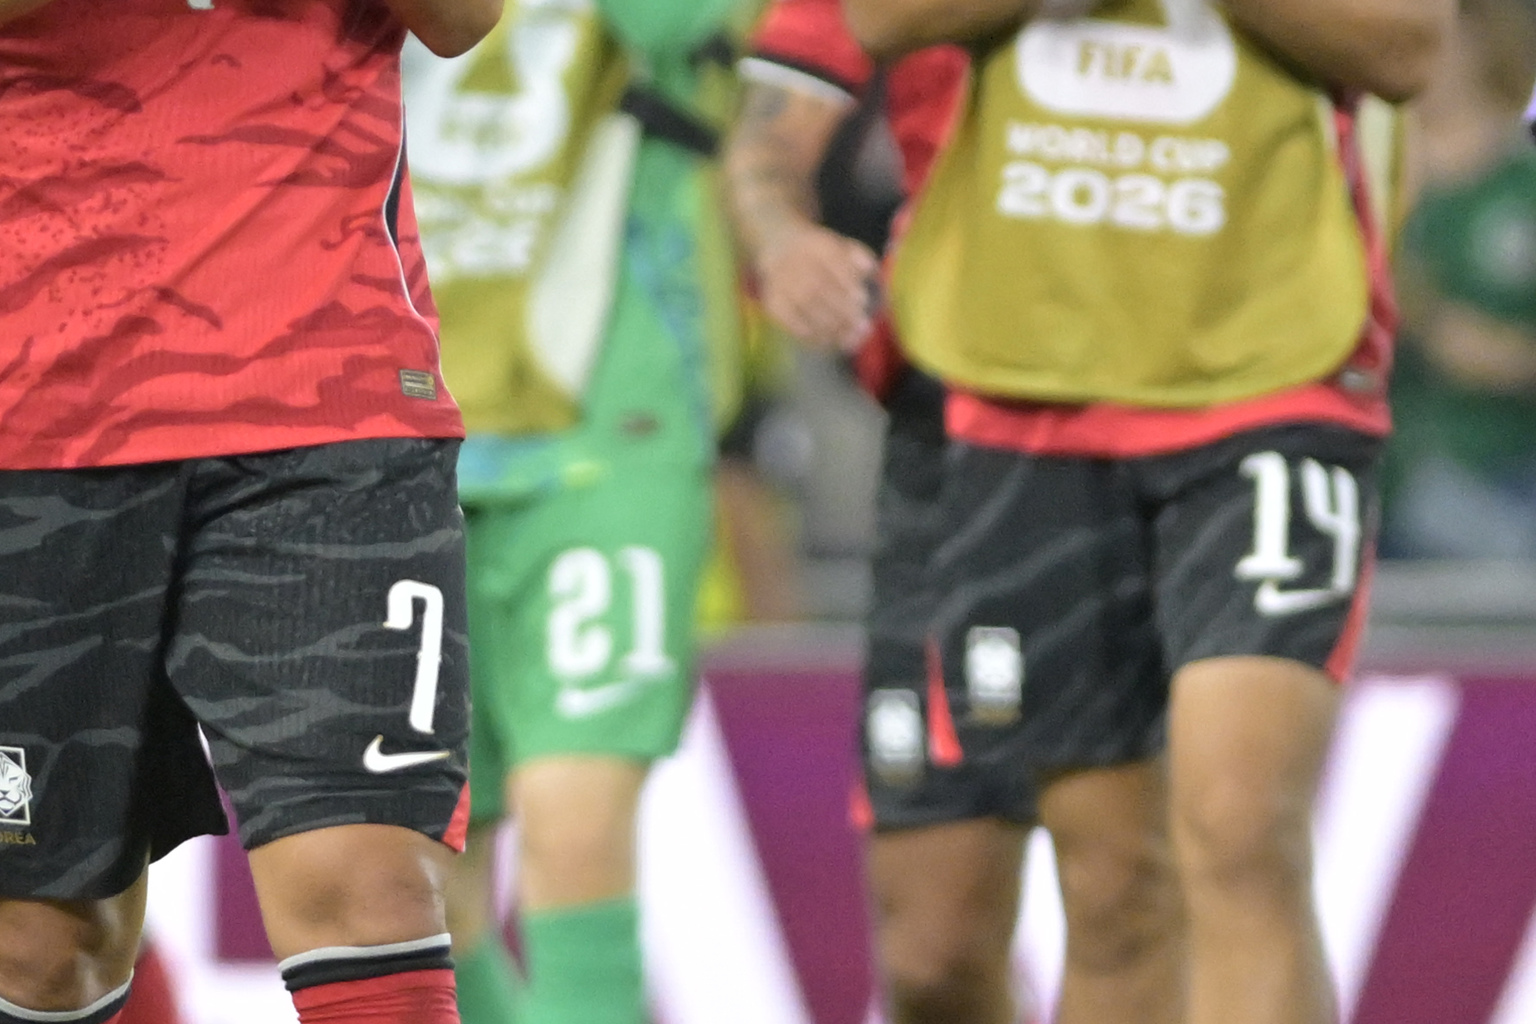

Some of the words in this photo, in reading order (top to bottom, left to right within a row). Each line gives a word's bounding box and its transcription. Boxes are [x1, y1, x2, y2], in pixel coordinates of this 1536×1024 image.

[1075, 38, 1175, 83] FIFA
[997, 160, 1229, 236] 2026
[1005, 118, 1146, 167] WORLD
[1151, 135, 1230, 173] CUP
[1235, 450, 1362, 597] 14
[383, 579, 444, 734] 7
[547, 543, 678, 677] 21
